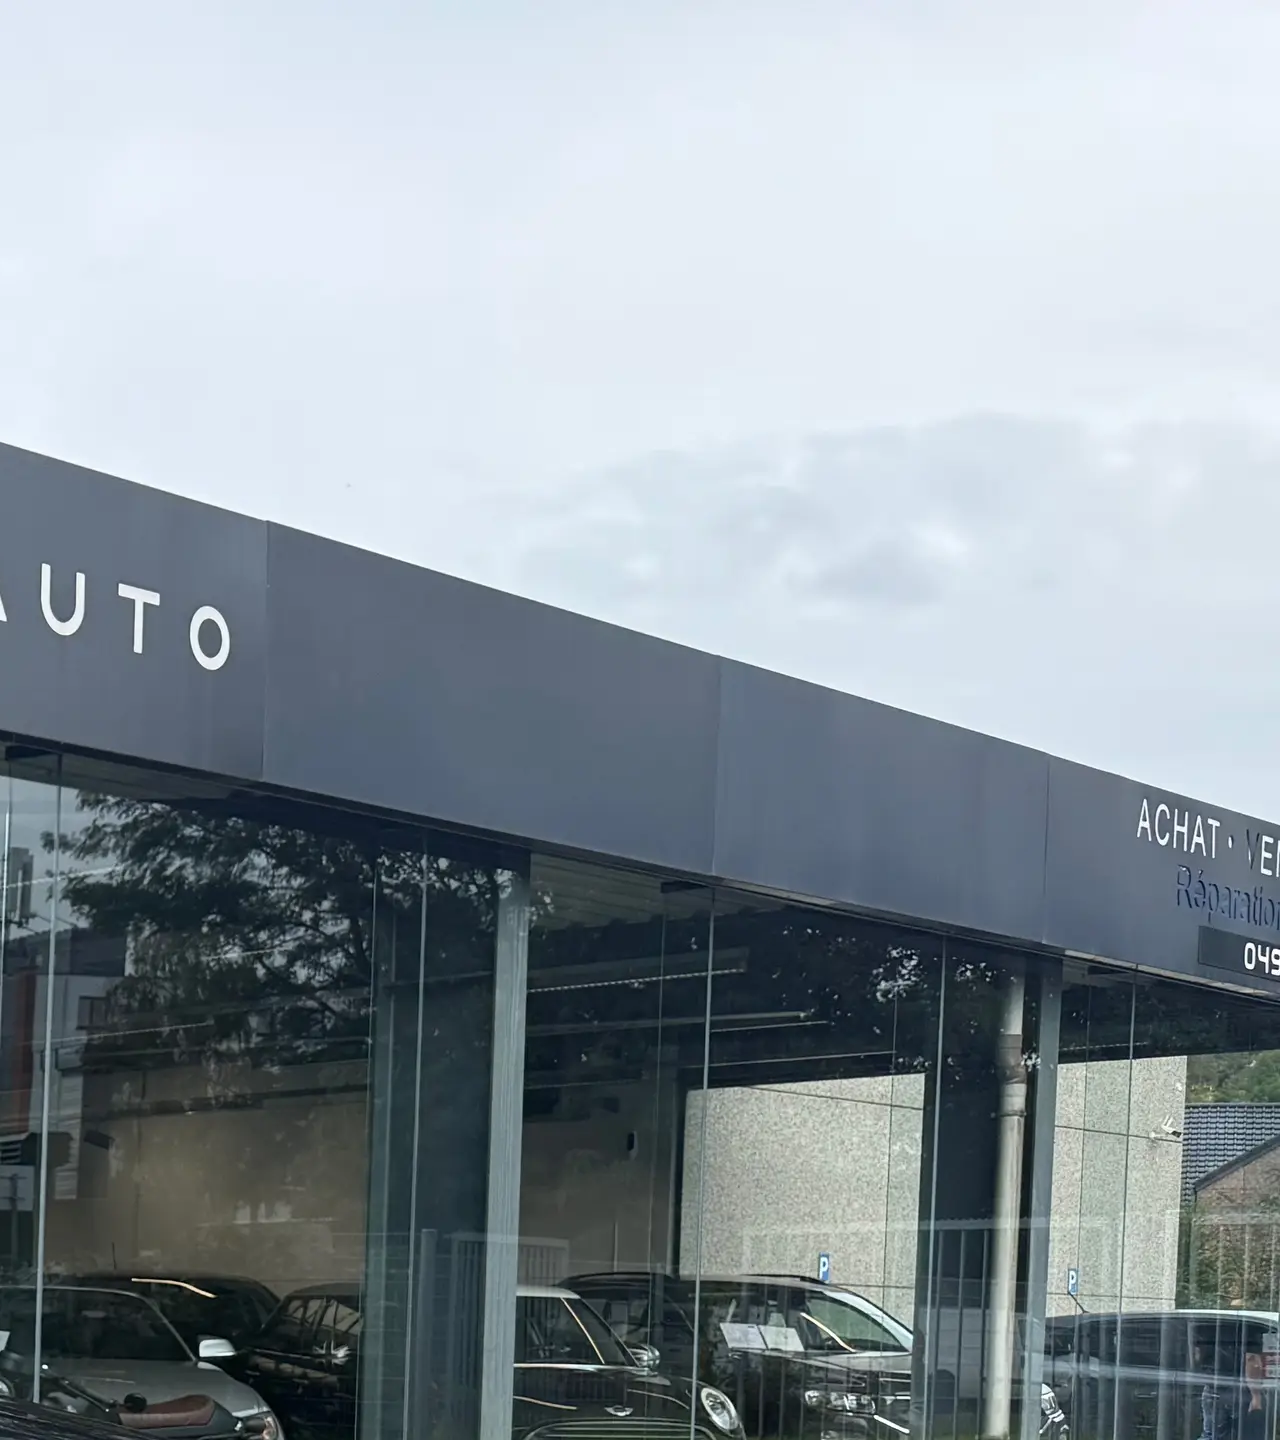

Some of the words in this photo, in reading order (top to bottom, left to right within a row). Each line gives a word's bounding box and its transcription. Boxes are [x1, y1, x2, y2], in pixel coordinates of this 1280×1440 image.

[1136, 798, 1221, 859] ACHAT
[1245, 828, 1280, 878] VE
[1176, 864, 1280, 931] Réparatio
[820, 1256, 829, 1280] P
[1069, 1270, 1077, 1292] P
